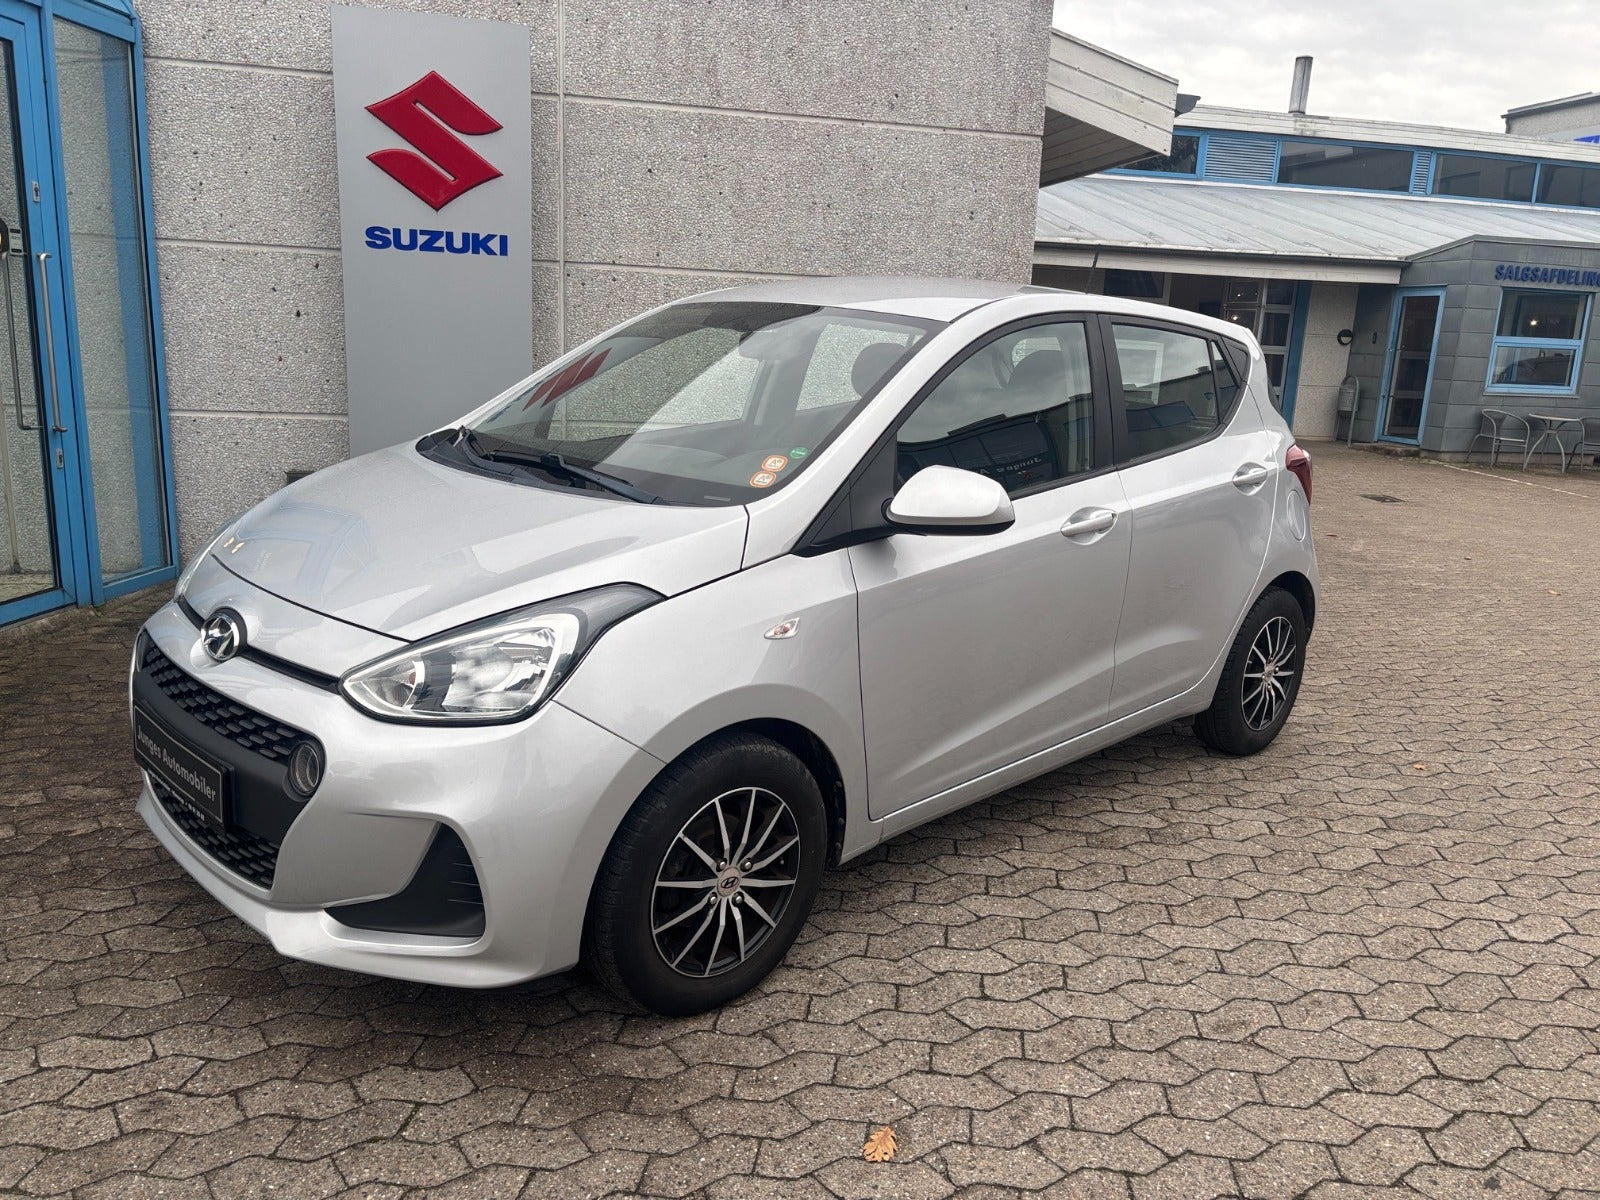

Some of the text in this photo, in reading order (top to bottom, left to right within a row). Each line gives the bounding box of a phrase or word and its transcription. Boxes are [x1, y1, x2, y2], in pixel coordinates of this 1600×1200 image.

[365, 226, 508, 256] SUZUKI
[137, 725, 161, 759] Junges
[163, 748, 216, 801] Automobiler
